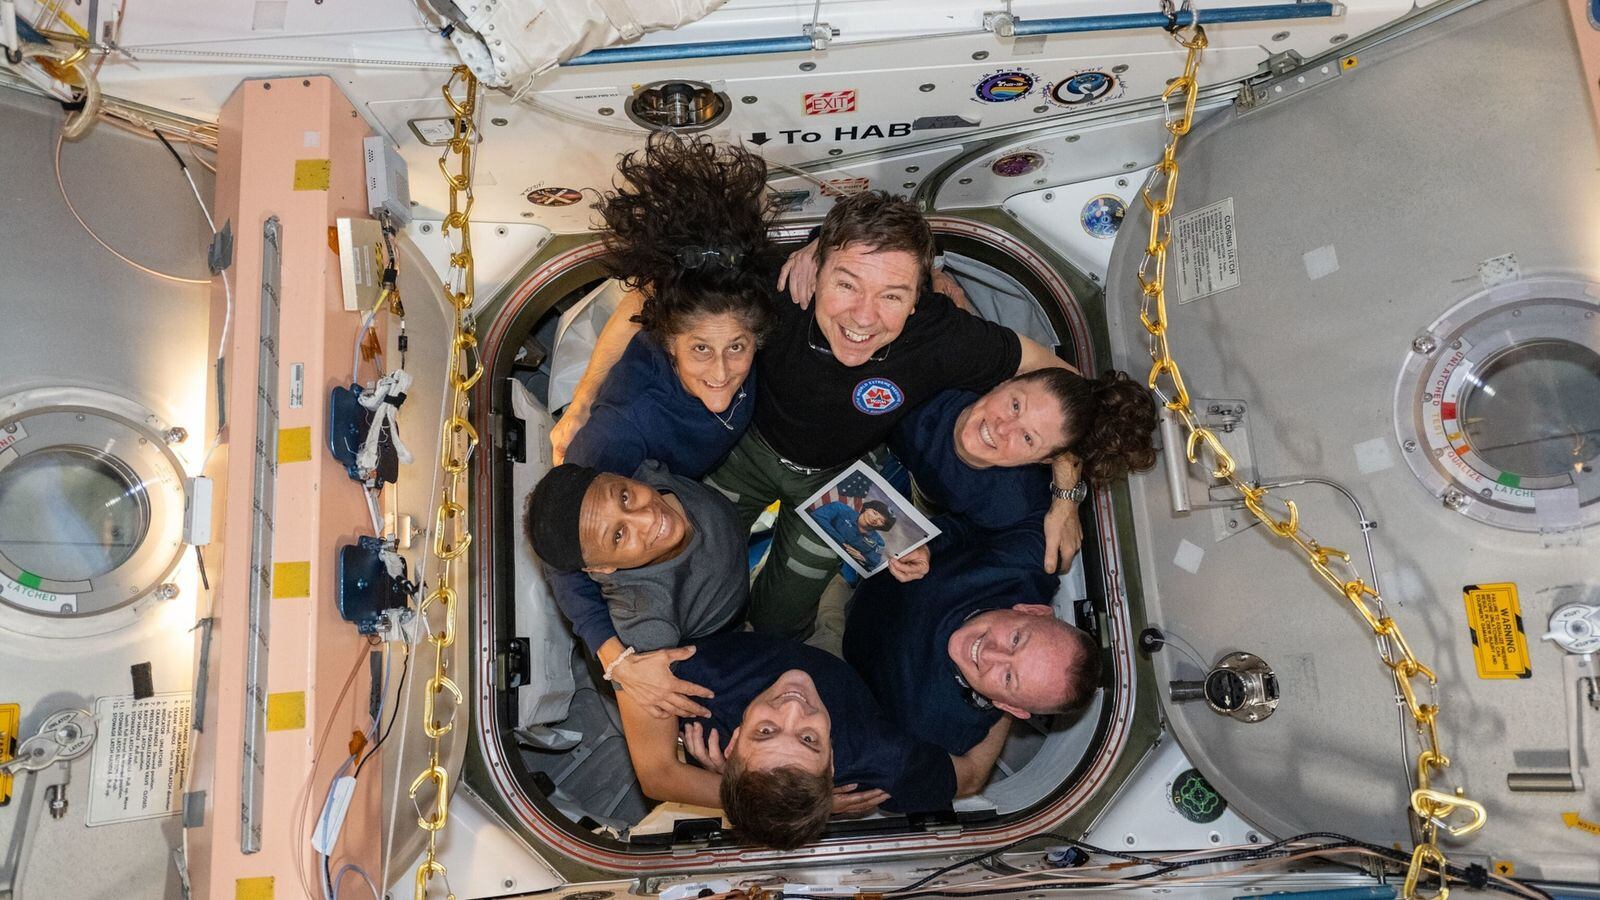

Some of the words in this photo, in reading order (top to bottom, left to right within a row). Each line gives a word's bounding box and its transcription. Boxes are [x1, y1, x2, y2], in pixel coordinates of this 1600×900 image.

[812, 96, 847, 110] EXIT
[779, 129, 822, 144] To
[834, 122, 912, 141] HAB
[1224, 215, 1233, 248] CLOSING
[857, 382, 868, 396] WORLD
[1432, 352, 1463, 406] UNLATCHED
[1432, 413, 1444, 436] TEST
[1444, 445, 1482, 483] EQUALIZE
[6, 581, 57, 602] LATCHED
[1476, 595, 1485, 621] EQUIPMENT
[1491, 594, 1499, 612] FAILURE
[1564, 610, 1581, 618] LATCH
[1489, 614, 1499, 645] UNLATCHING
[1496, 623, 1504, 644] EQUALIZE
[1500, 608, 1516, 653] WARNING
[1499, 646, 1508, 670] PRESSURE
[48, 714, 72, 729] UNLATCH
[68, 740, 85, 752] LATCH
